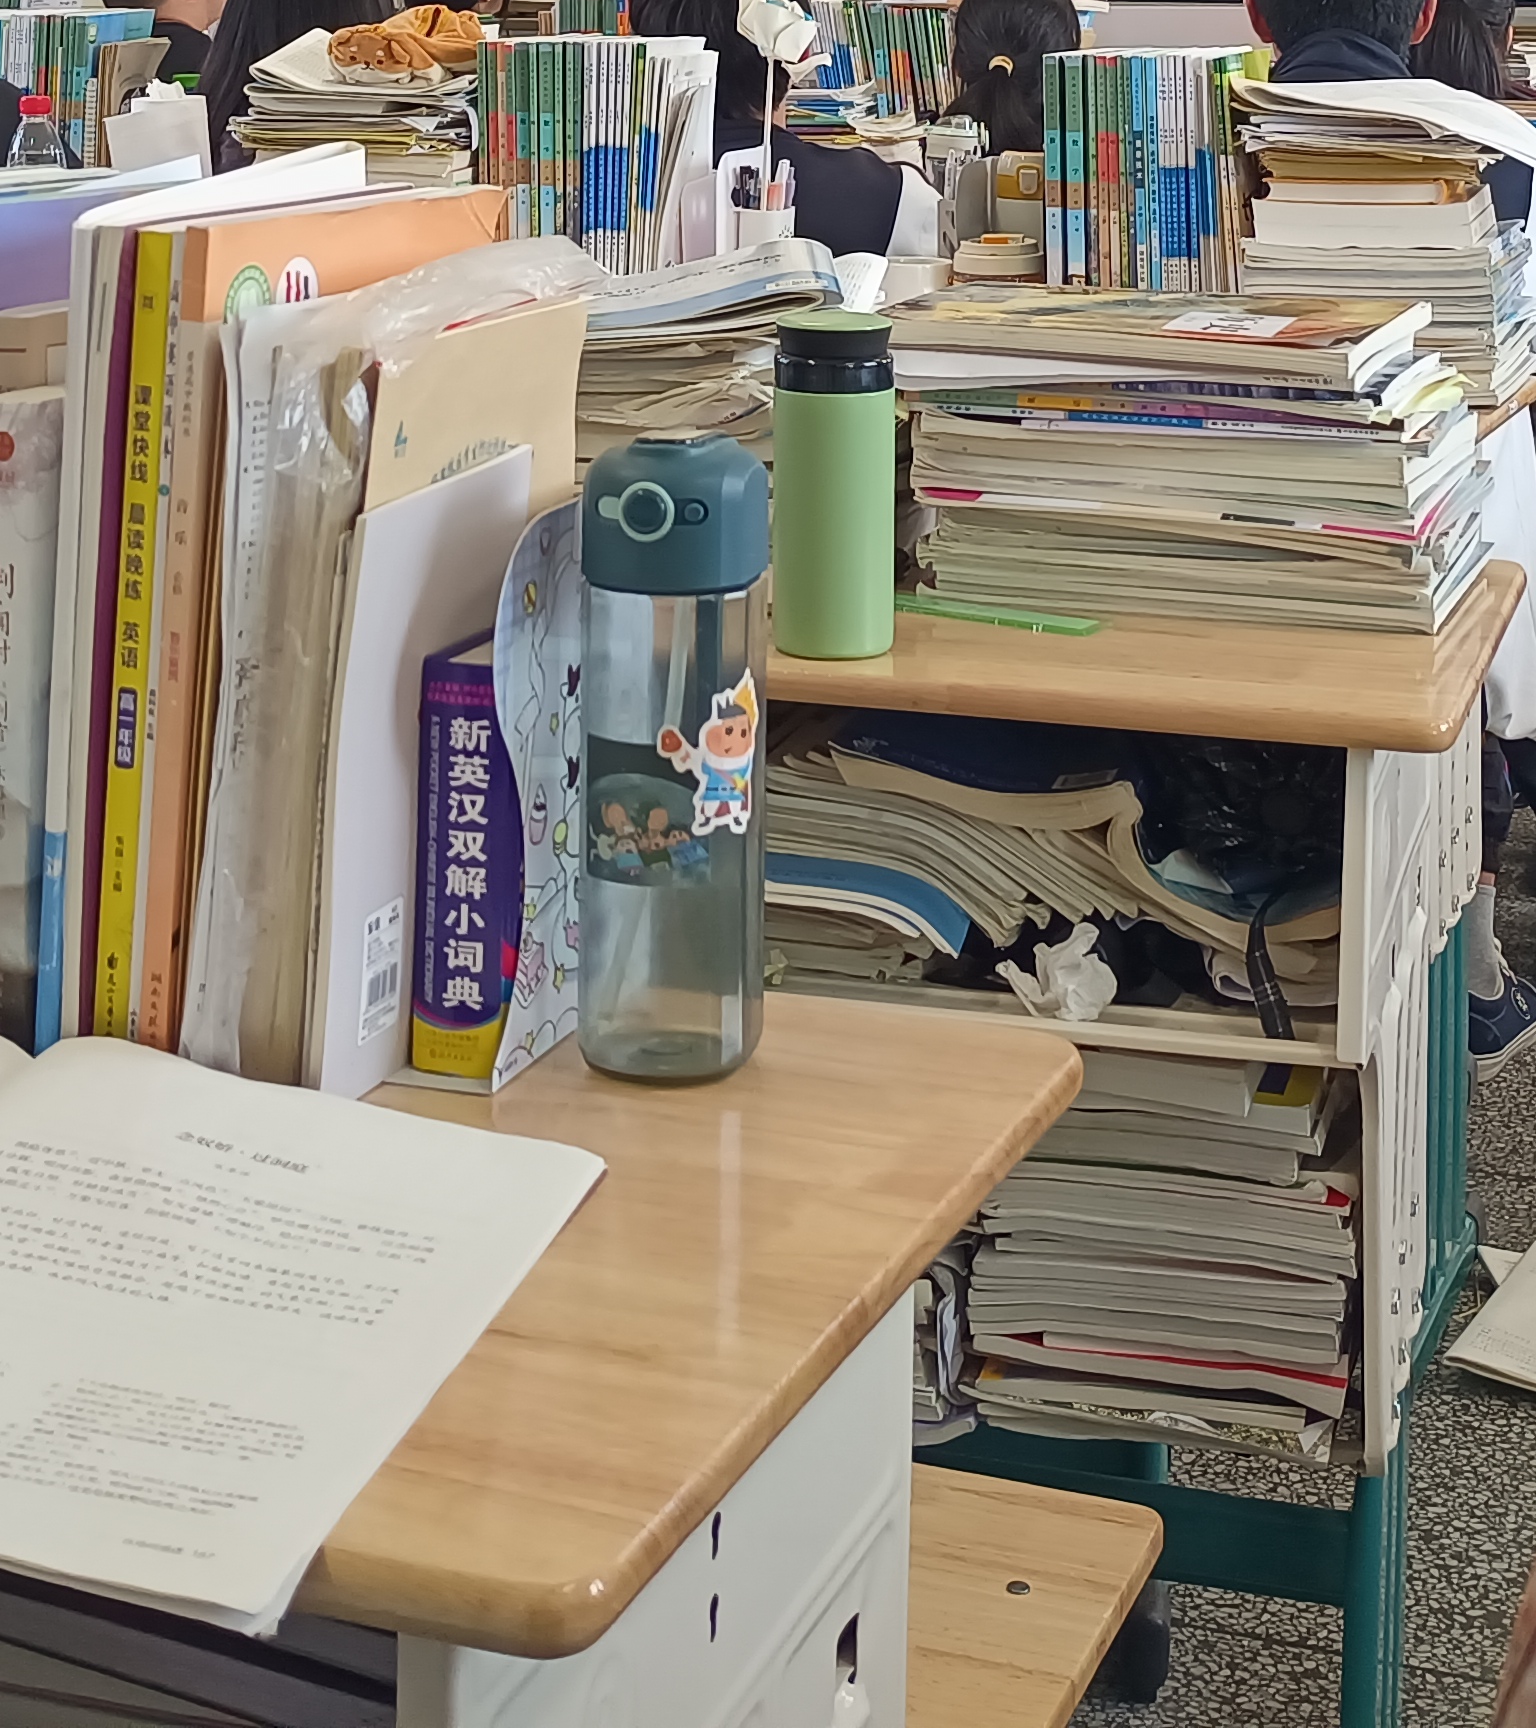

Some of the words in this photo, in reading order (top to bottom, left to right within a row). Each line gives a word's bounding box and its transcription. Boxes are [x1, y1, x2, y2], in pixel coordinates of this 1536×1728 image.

[130, 384, 153, 484] 课堂快线
[124, 502, 145, 601] 晨读晚练
[121, 620, 140, 670] 英语
[442, 716, 492, 1011] 新英汉双解小词典
